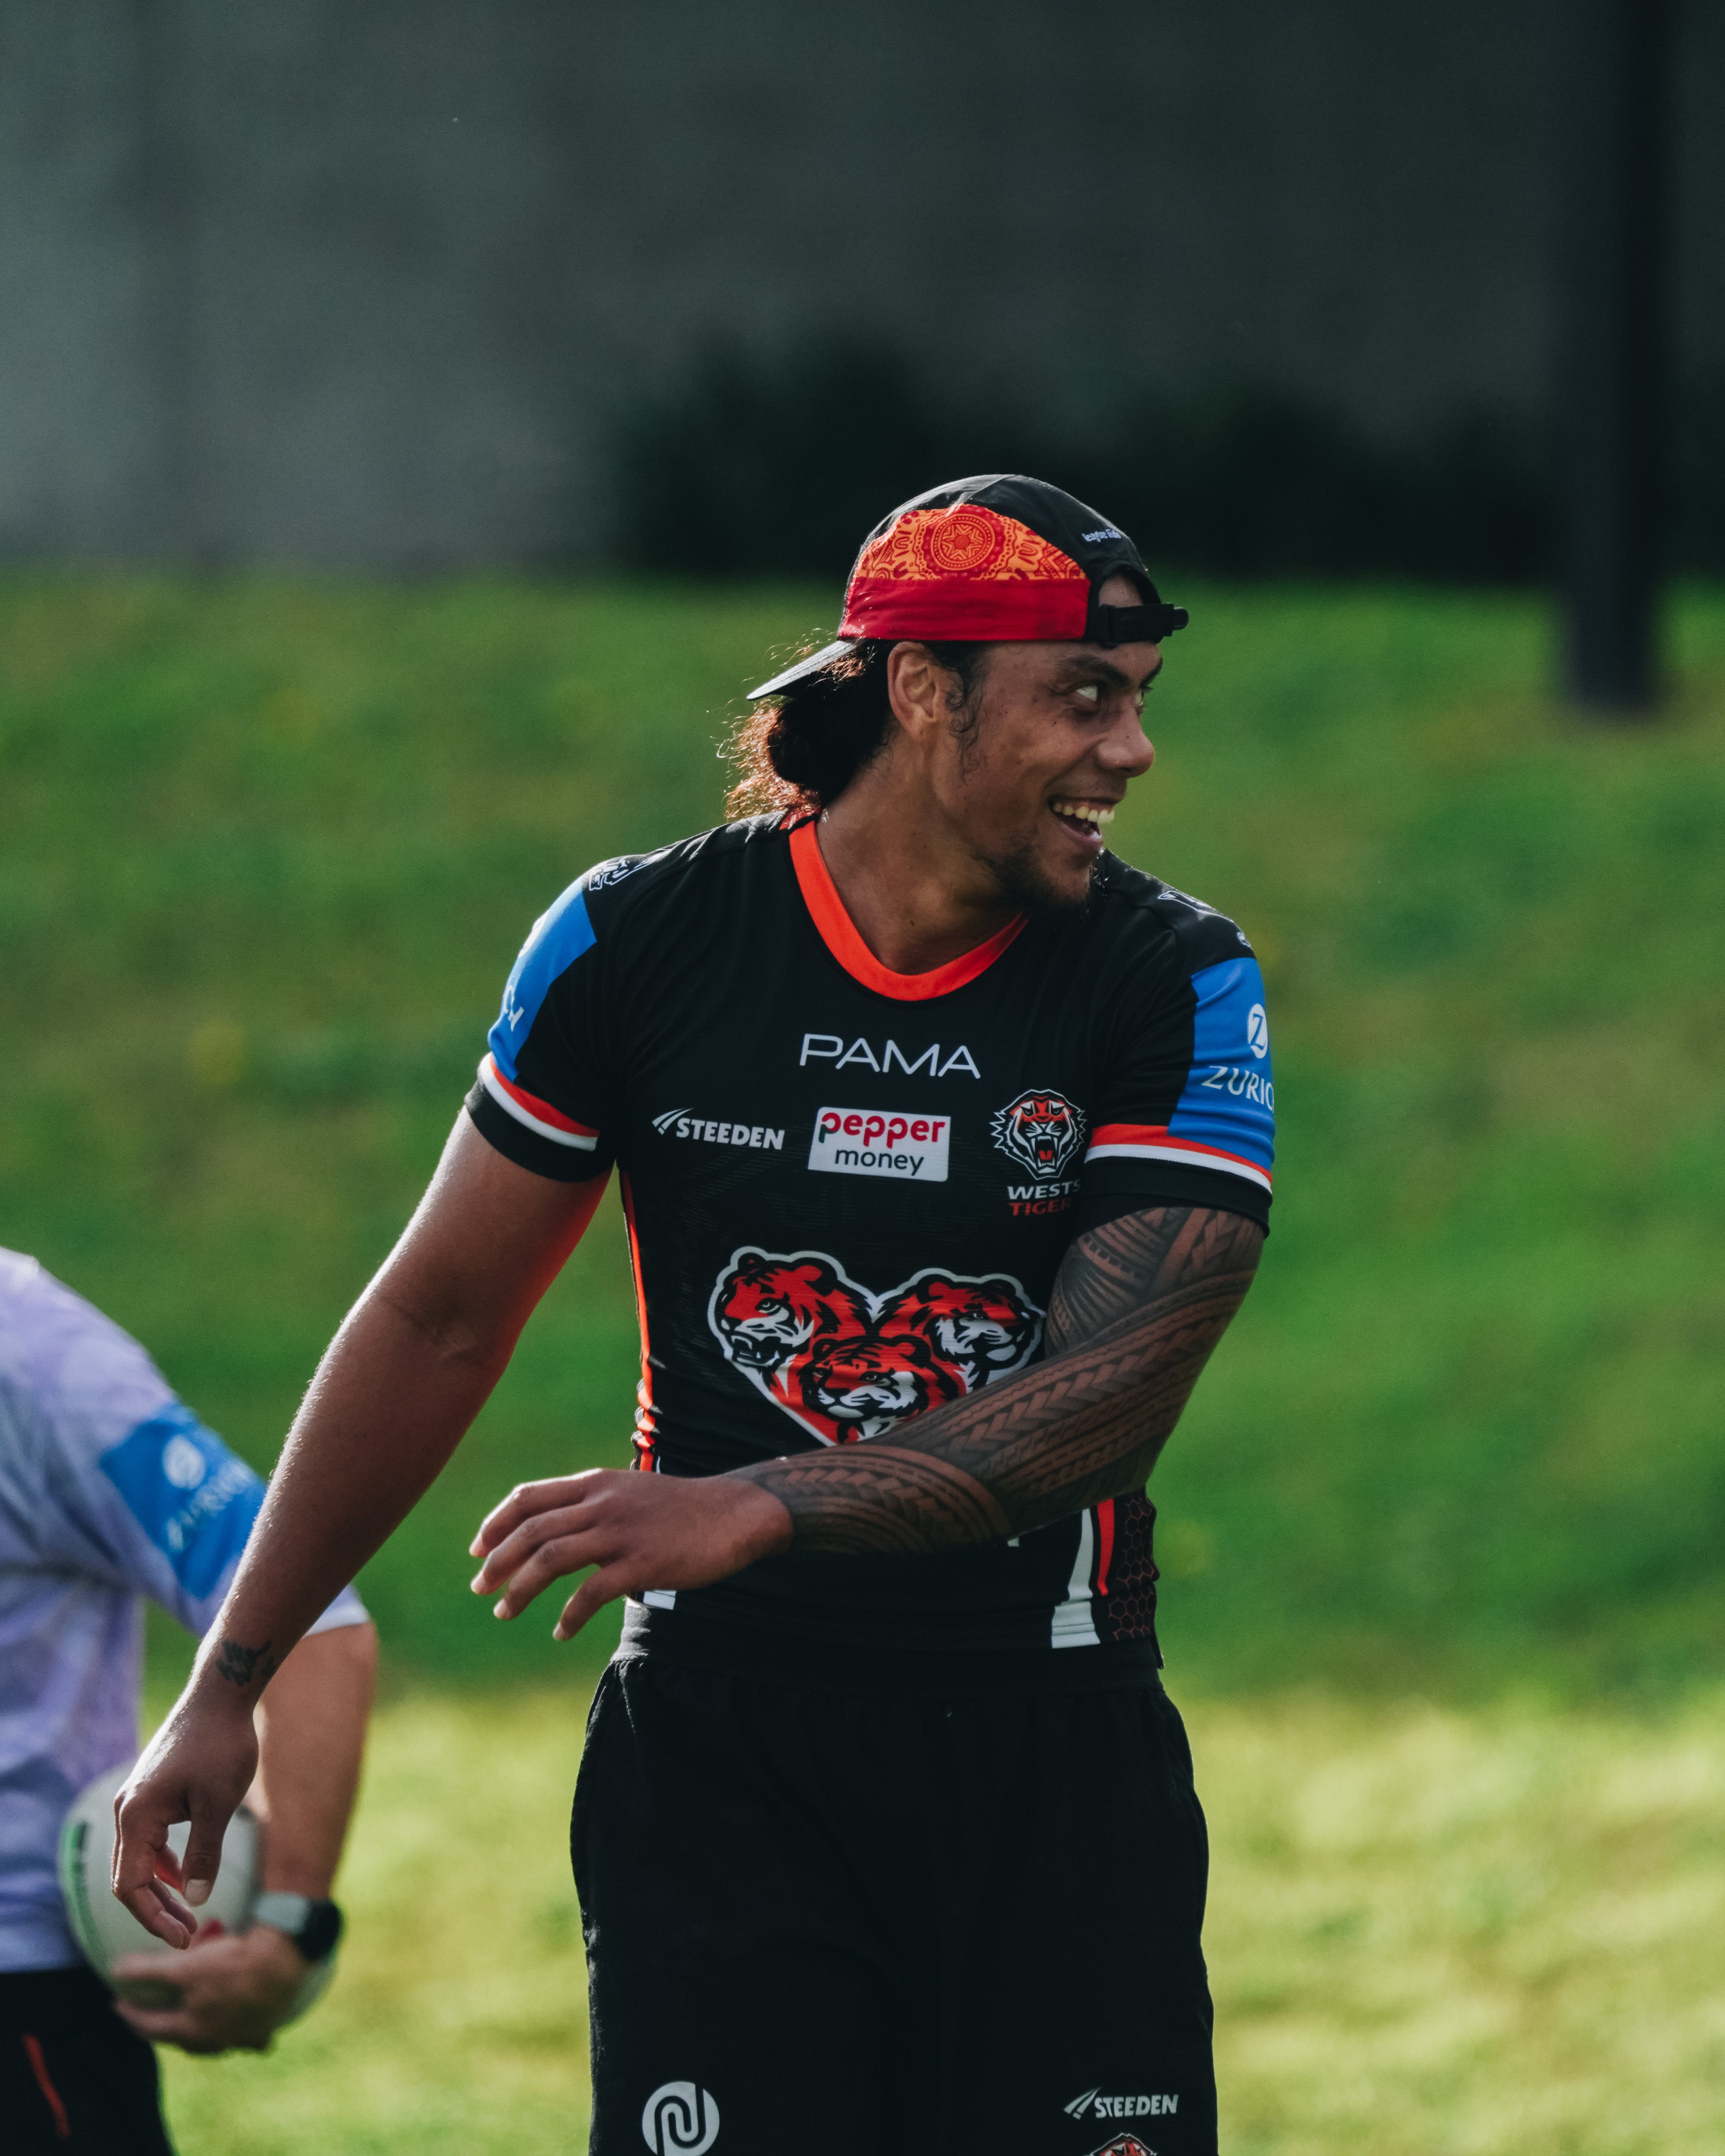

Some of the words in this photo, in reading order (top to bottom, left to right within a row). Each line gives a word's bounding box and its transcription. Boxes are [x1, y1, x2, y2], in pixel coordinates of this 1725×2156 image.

[800, 1033, 981, 1079] PAMA
[1201, 1065, 1274, 1113] ZURIC
[676, 1118, 785, 1150] STEEDEN
[818, 1112, 946, 1149] pepper
[835, 1150, 925, 1176] money
[1007, 1179, 1081, 1200] WESTS
[1009, 1197, 1072, 1217] TIGER
[1094, 2094, 1179, 2119] STEEDEN
